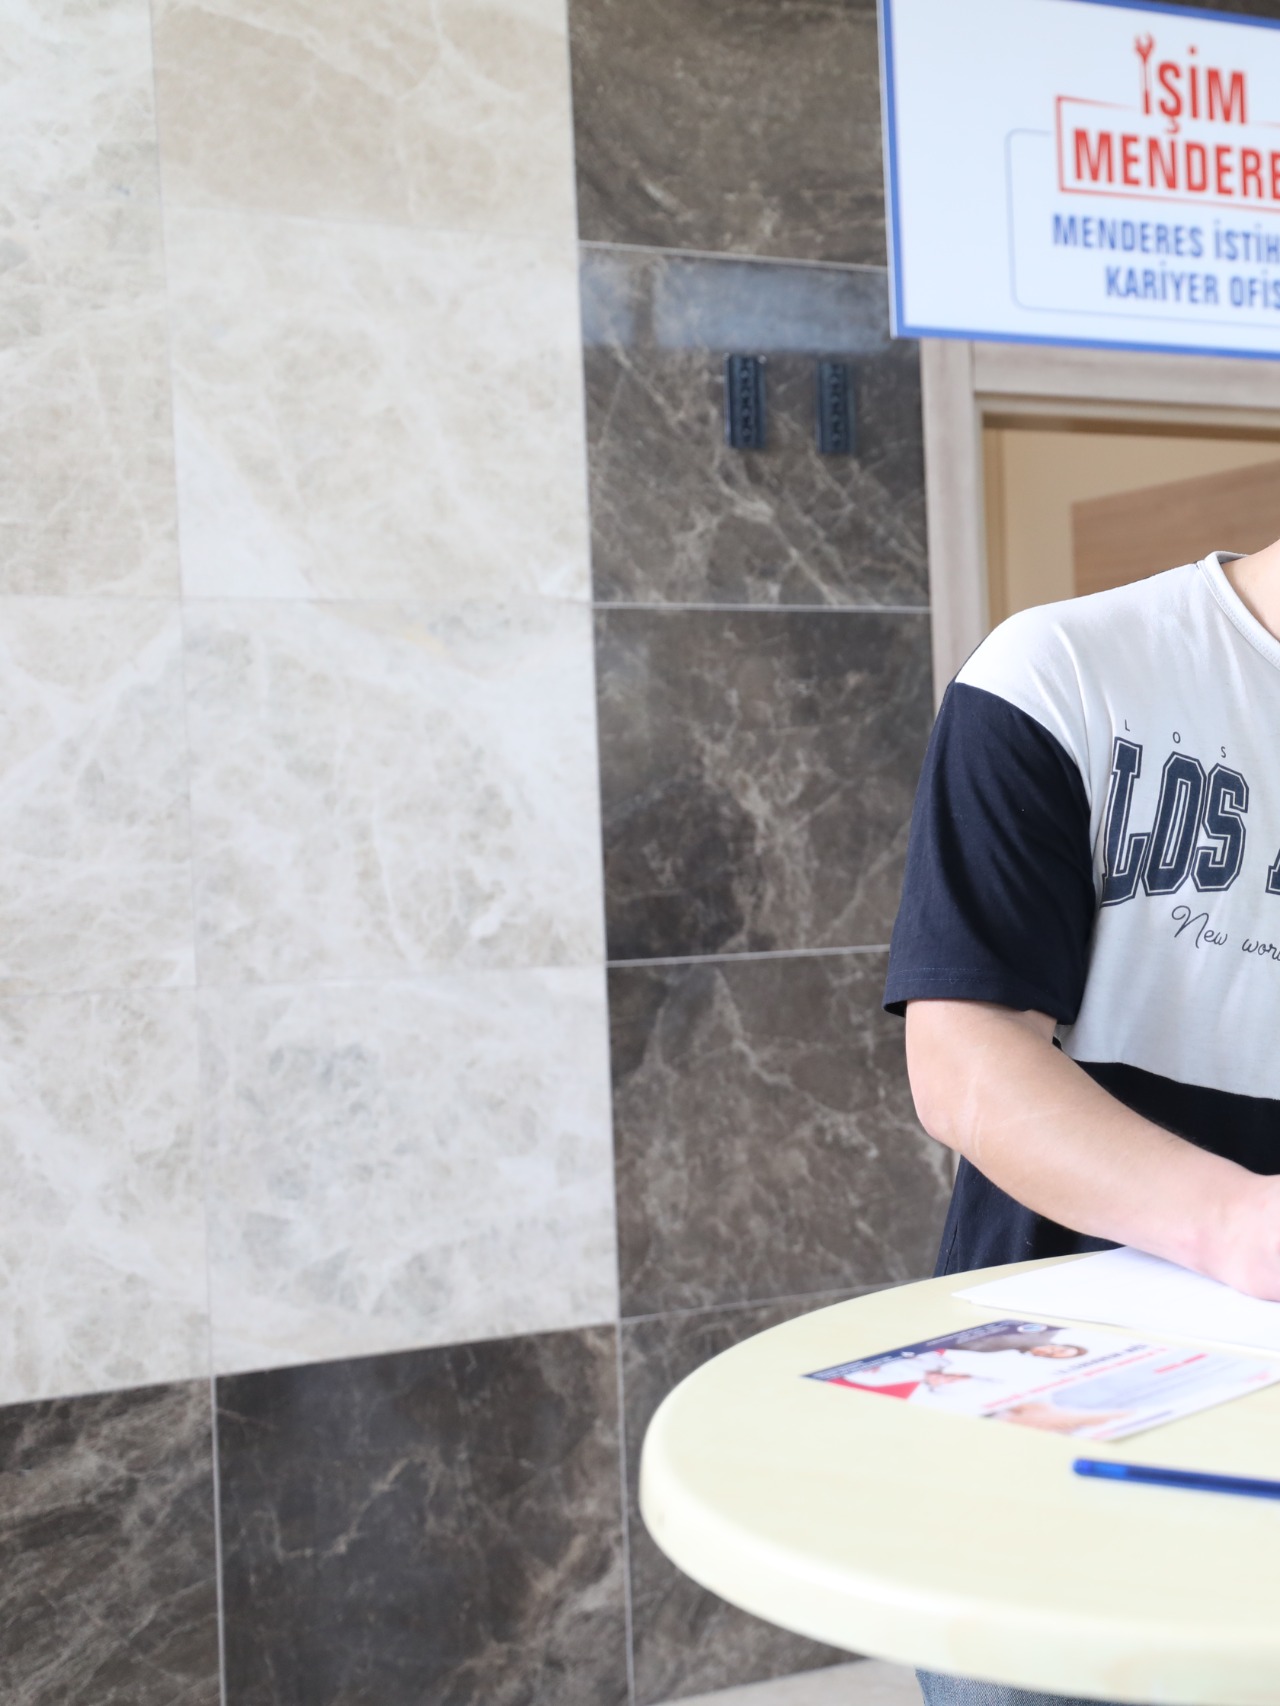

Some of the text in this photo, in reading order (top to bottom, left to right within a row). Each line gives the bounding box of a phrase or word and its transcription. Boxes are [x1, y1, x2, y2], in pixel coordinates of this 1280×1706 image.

[1052, 213, 1205, 260] MENDERES
[1104, 259, 1221, 307] KARİYER
[1124, 718, 1228, 760] LOS
[1100, 735, 1250, 910] LOS
[1170, 904, 1229, 950] New
